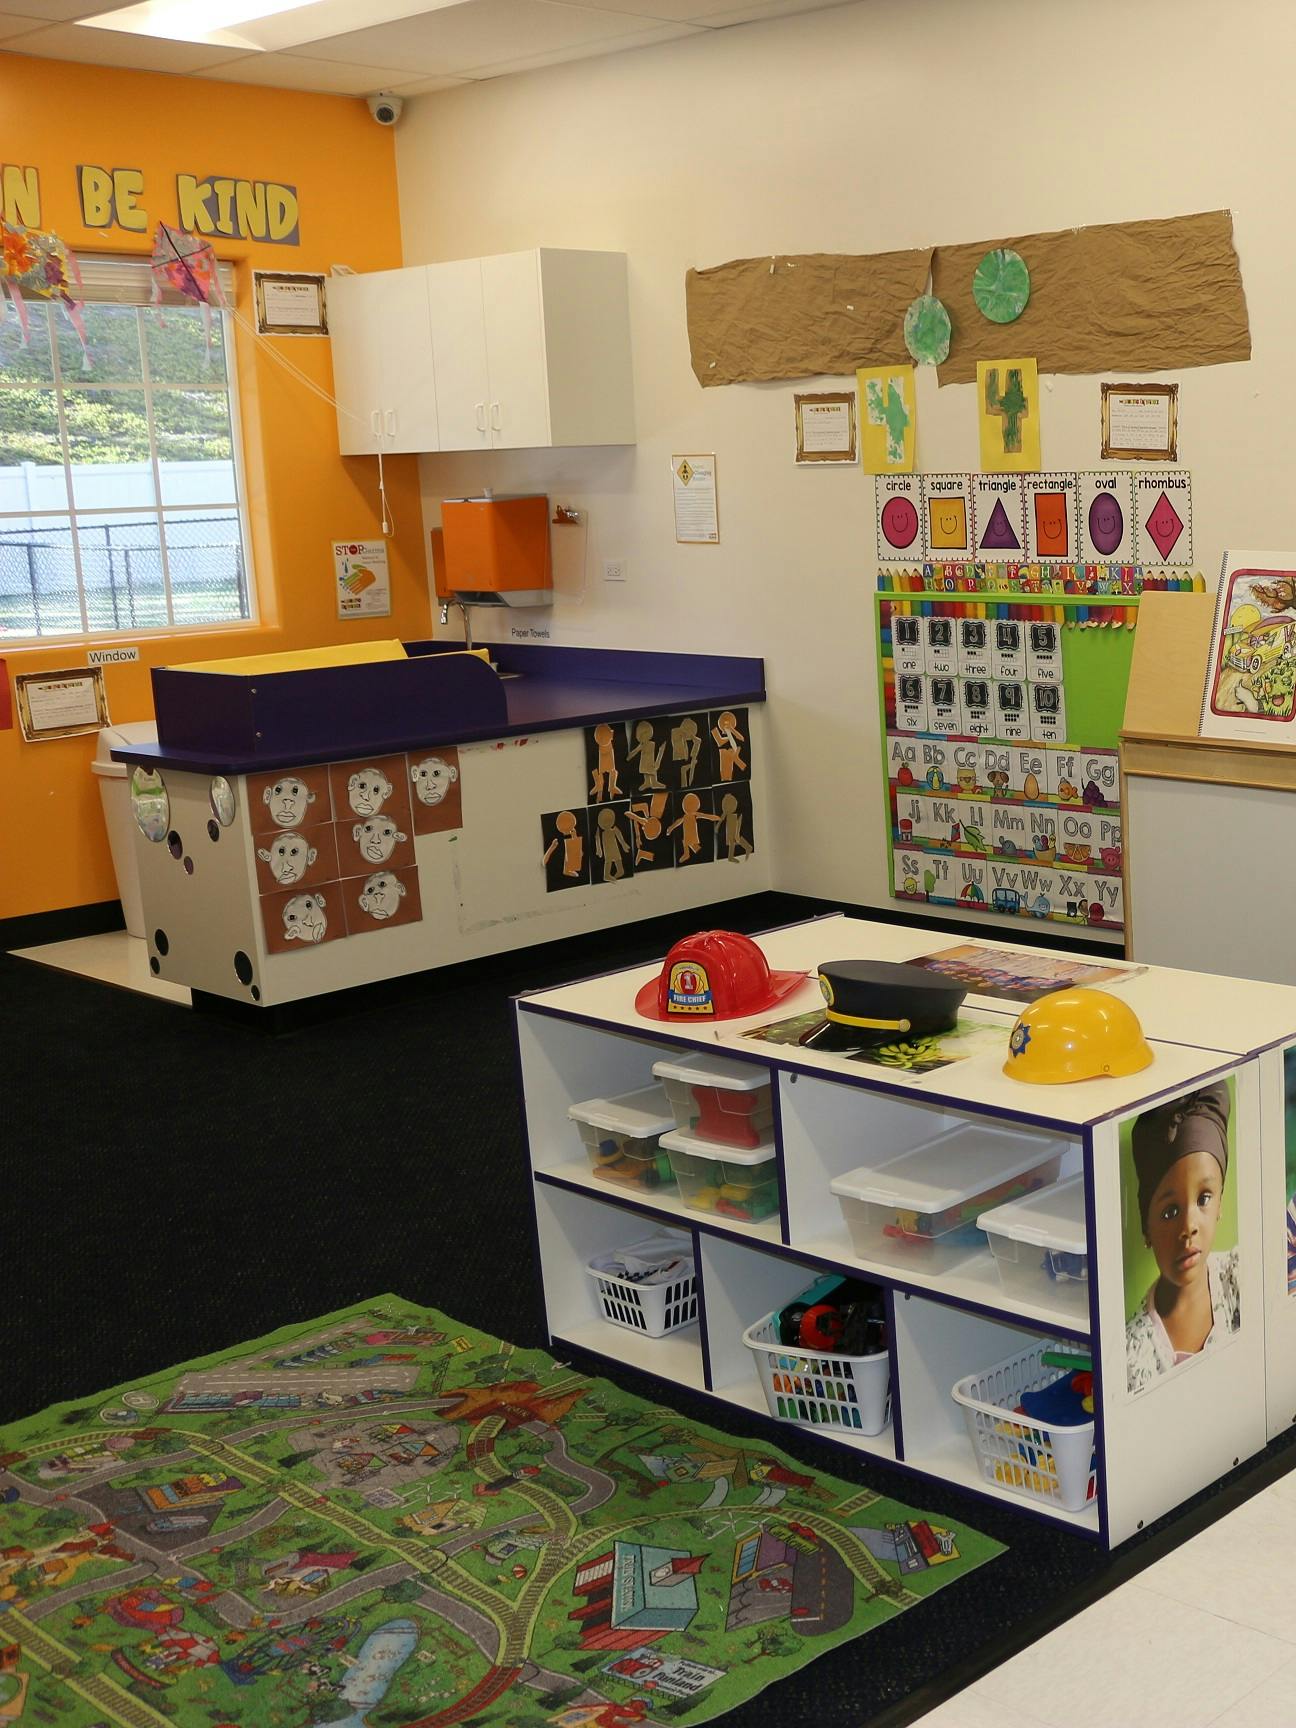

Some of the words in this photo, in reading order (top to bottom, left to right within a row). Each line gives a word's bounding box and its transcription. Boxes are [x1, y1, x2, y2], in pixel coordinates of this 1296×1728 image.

[1, 166, 40, 229] N
[81, 166, 147, 229] BE
[177, 174, 298, 240] KIND
[886, 480, 912, 491] circle
[930, 480, 963, 492] square
[978, 479, 1017, 493] triangle
[1026, 479, 1073, 492] rectangle
[1095, 478, 1117, 489] oval
[1138, 477, 1187, 489] rhombus
[511, 628, 529, 639] Paper
[905, 623, 911, 640] 1
[935, 625, 944, 642] 2
[969, 626, 979, 643] 3
[1003, 628, 1013, 645] 4
[1037, 629, 1048, 647] 5
[89, 650, 136, 663] Window
[902, 661, 916, 670] one
[934, 664, 950, 672] two
[965, 665, 987, 675] three
[1001, 667, 1018, 677] four
[1037, 669, 1054, 679] five
[905, 682, 914, 697] 6
[937, 683, 947, 699] 7
[971, 686, 981, 703] 8
[1005, 687, 1015, 705] 9
[1040, 690, 1054, 707] 10
[906, 717, 917, 727] six
[934, 722, 957, 731] seven
[969, 725, 988, 736] eight
[1005, 727, 1022, 736] nine
[1042, 729, 1057, 740] ten
[892, 742, 916, 763] Aa
[923, 744, 945, 766] Bb
[954, 746, 977, 768] Cc
[984, 750, 1010, 772] Dd
[1020, 752, 1042, 775] Ee
[1056, 756, 1075, 778] Ff
[1086, 758, 1115, 787] Gg
[908, 799, 921, 823] Jj
[933, 802, 956, 824] Kk
[970, 806, 983, 827] Ll
[993, 809, 1024, 831] Mm
[1030, 812, 1056, 835] Nn
[1064, 816, 1092, 839] Oo
[902, 854, 919, 876] Ss
[933, 859, 949, 881] Tt
[962, 862, 983, 885] Uu
[992, 866, 1018, 889] Vv
[1020, 869, 1052, 892] Ww
[1059, 874, 1085, 898] Xx
[1094, 879, 1119, 908] Yy
[684, 974, 694, 990] 1
[673, 994, 687, 1002] FIRE
[687, 996, 706, 1004] CHIEF
[652, 1671, 703, 1692] Funland
[672, 1666, 706, 1682] Train
